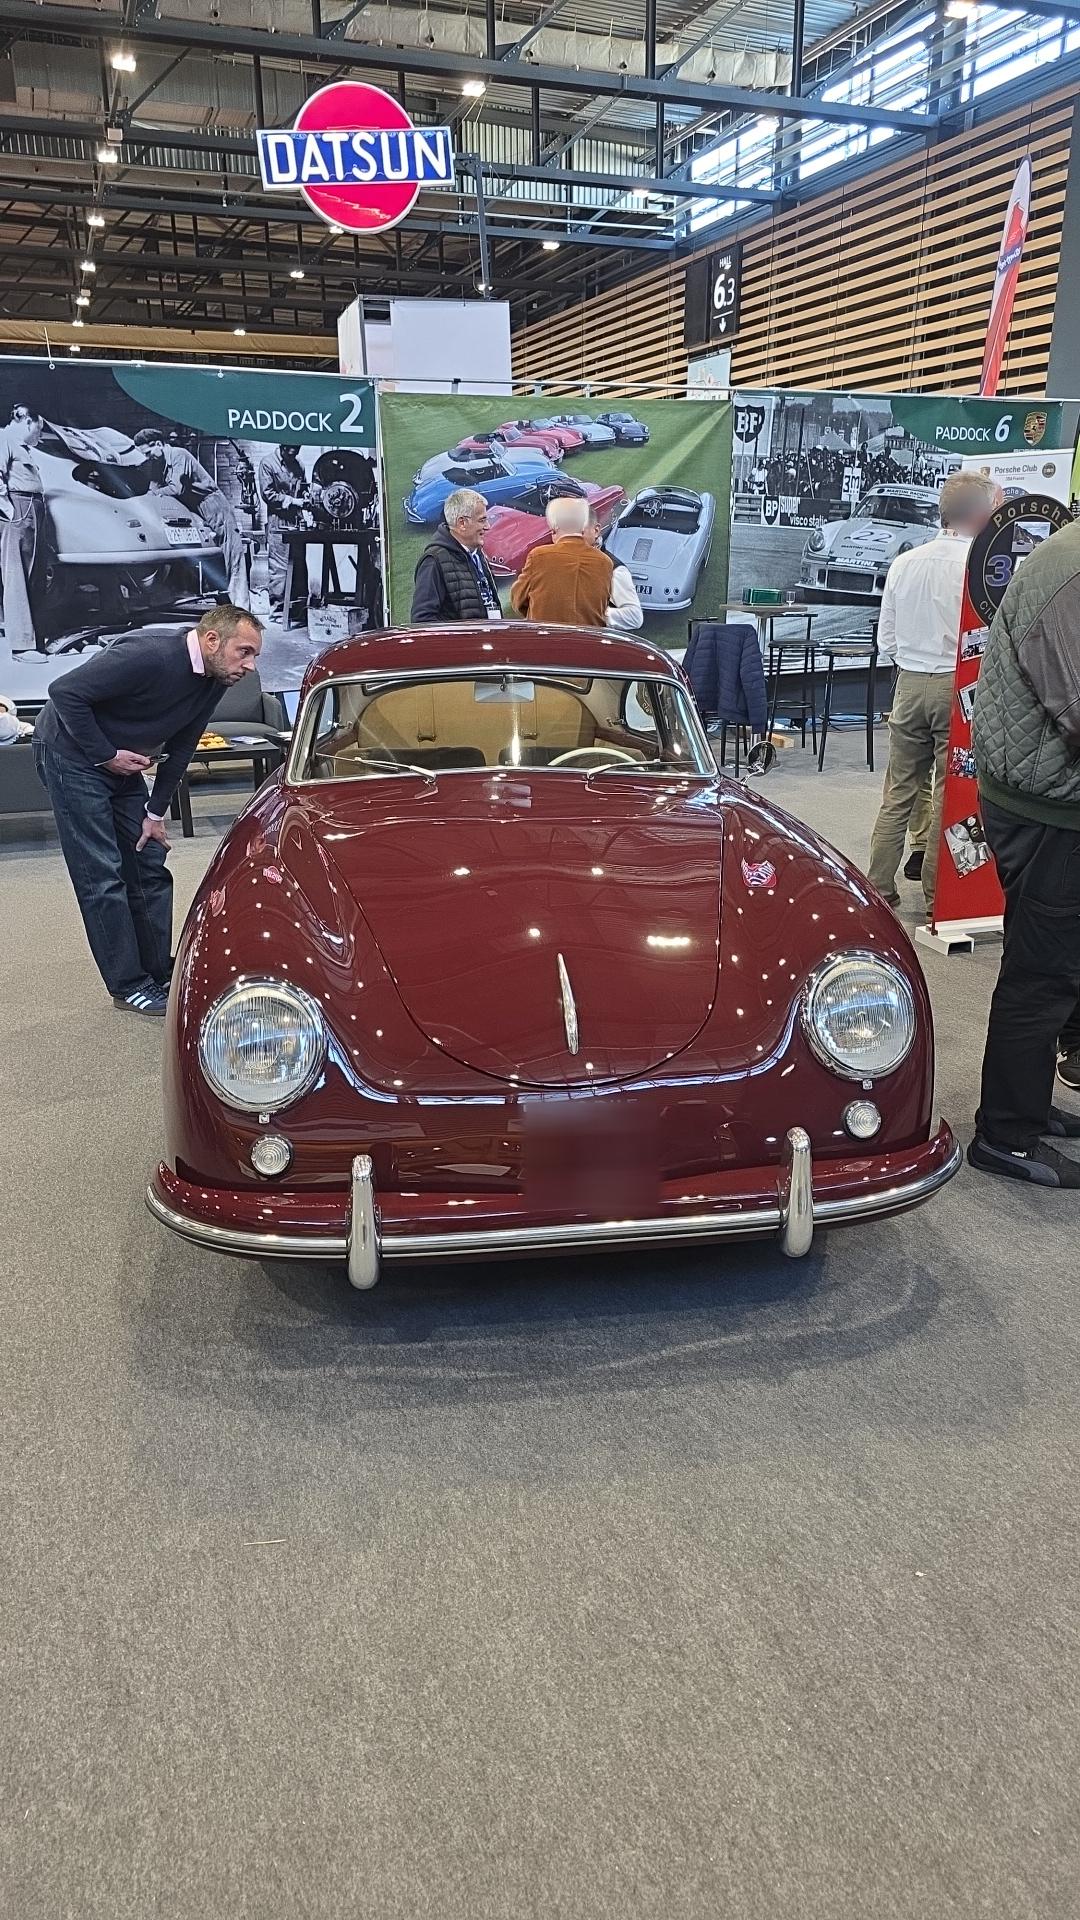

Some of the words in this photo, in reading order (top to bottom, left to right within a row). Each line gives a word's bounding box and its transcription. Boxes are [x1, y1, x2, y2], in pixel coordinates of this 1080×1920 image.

[266, 131, 447, 183] DATSUN
[713, 273, 736, 309] 6.3
[227, 408, 334, 432] PADDOCK
[339, 393, 364, 433] 2
[935, 426, 992, 442] PADDOCK
[994, 414, 1013, 442] 6
[994, 465, 1021, 474] Porsche
[1022, 464, 1038, 473] Club
[765, 500, 778, 517] BP
[780, 496, 800, 517] super
[790, 514, 808, 526] visco
[852, 530, 892, 544] 22
[834, 557, 875, 567] MARTINI
[979, 600, 995, 620] Clu
